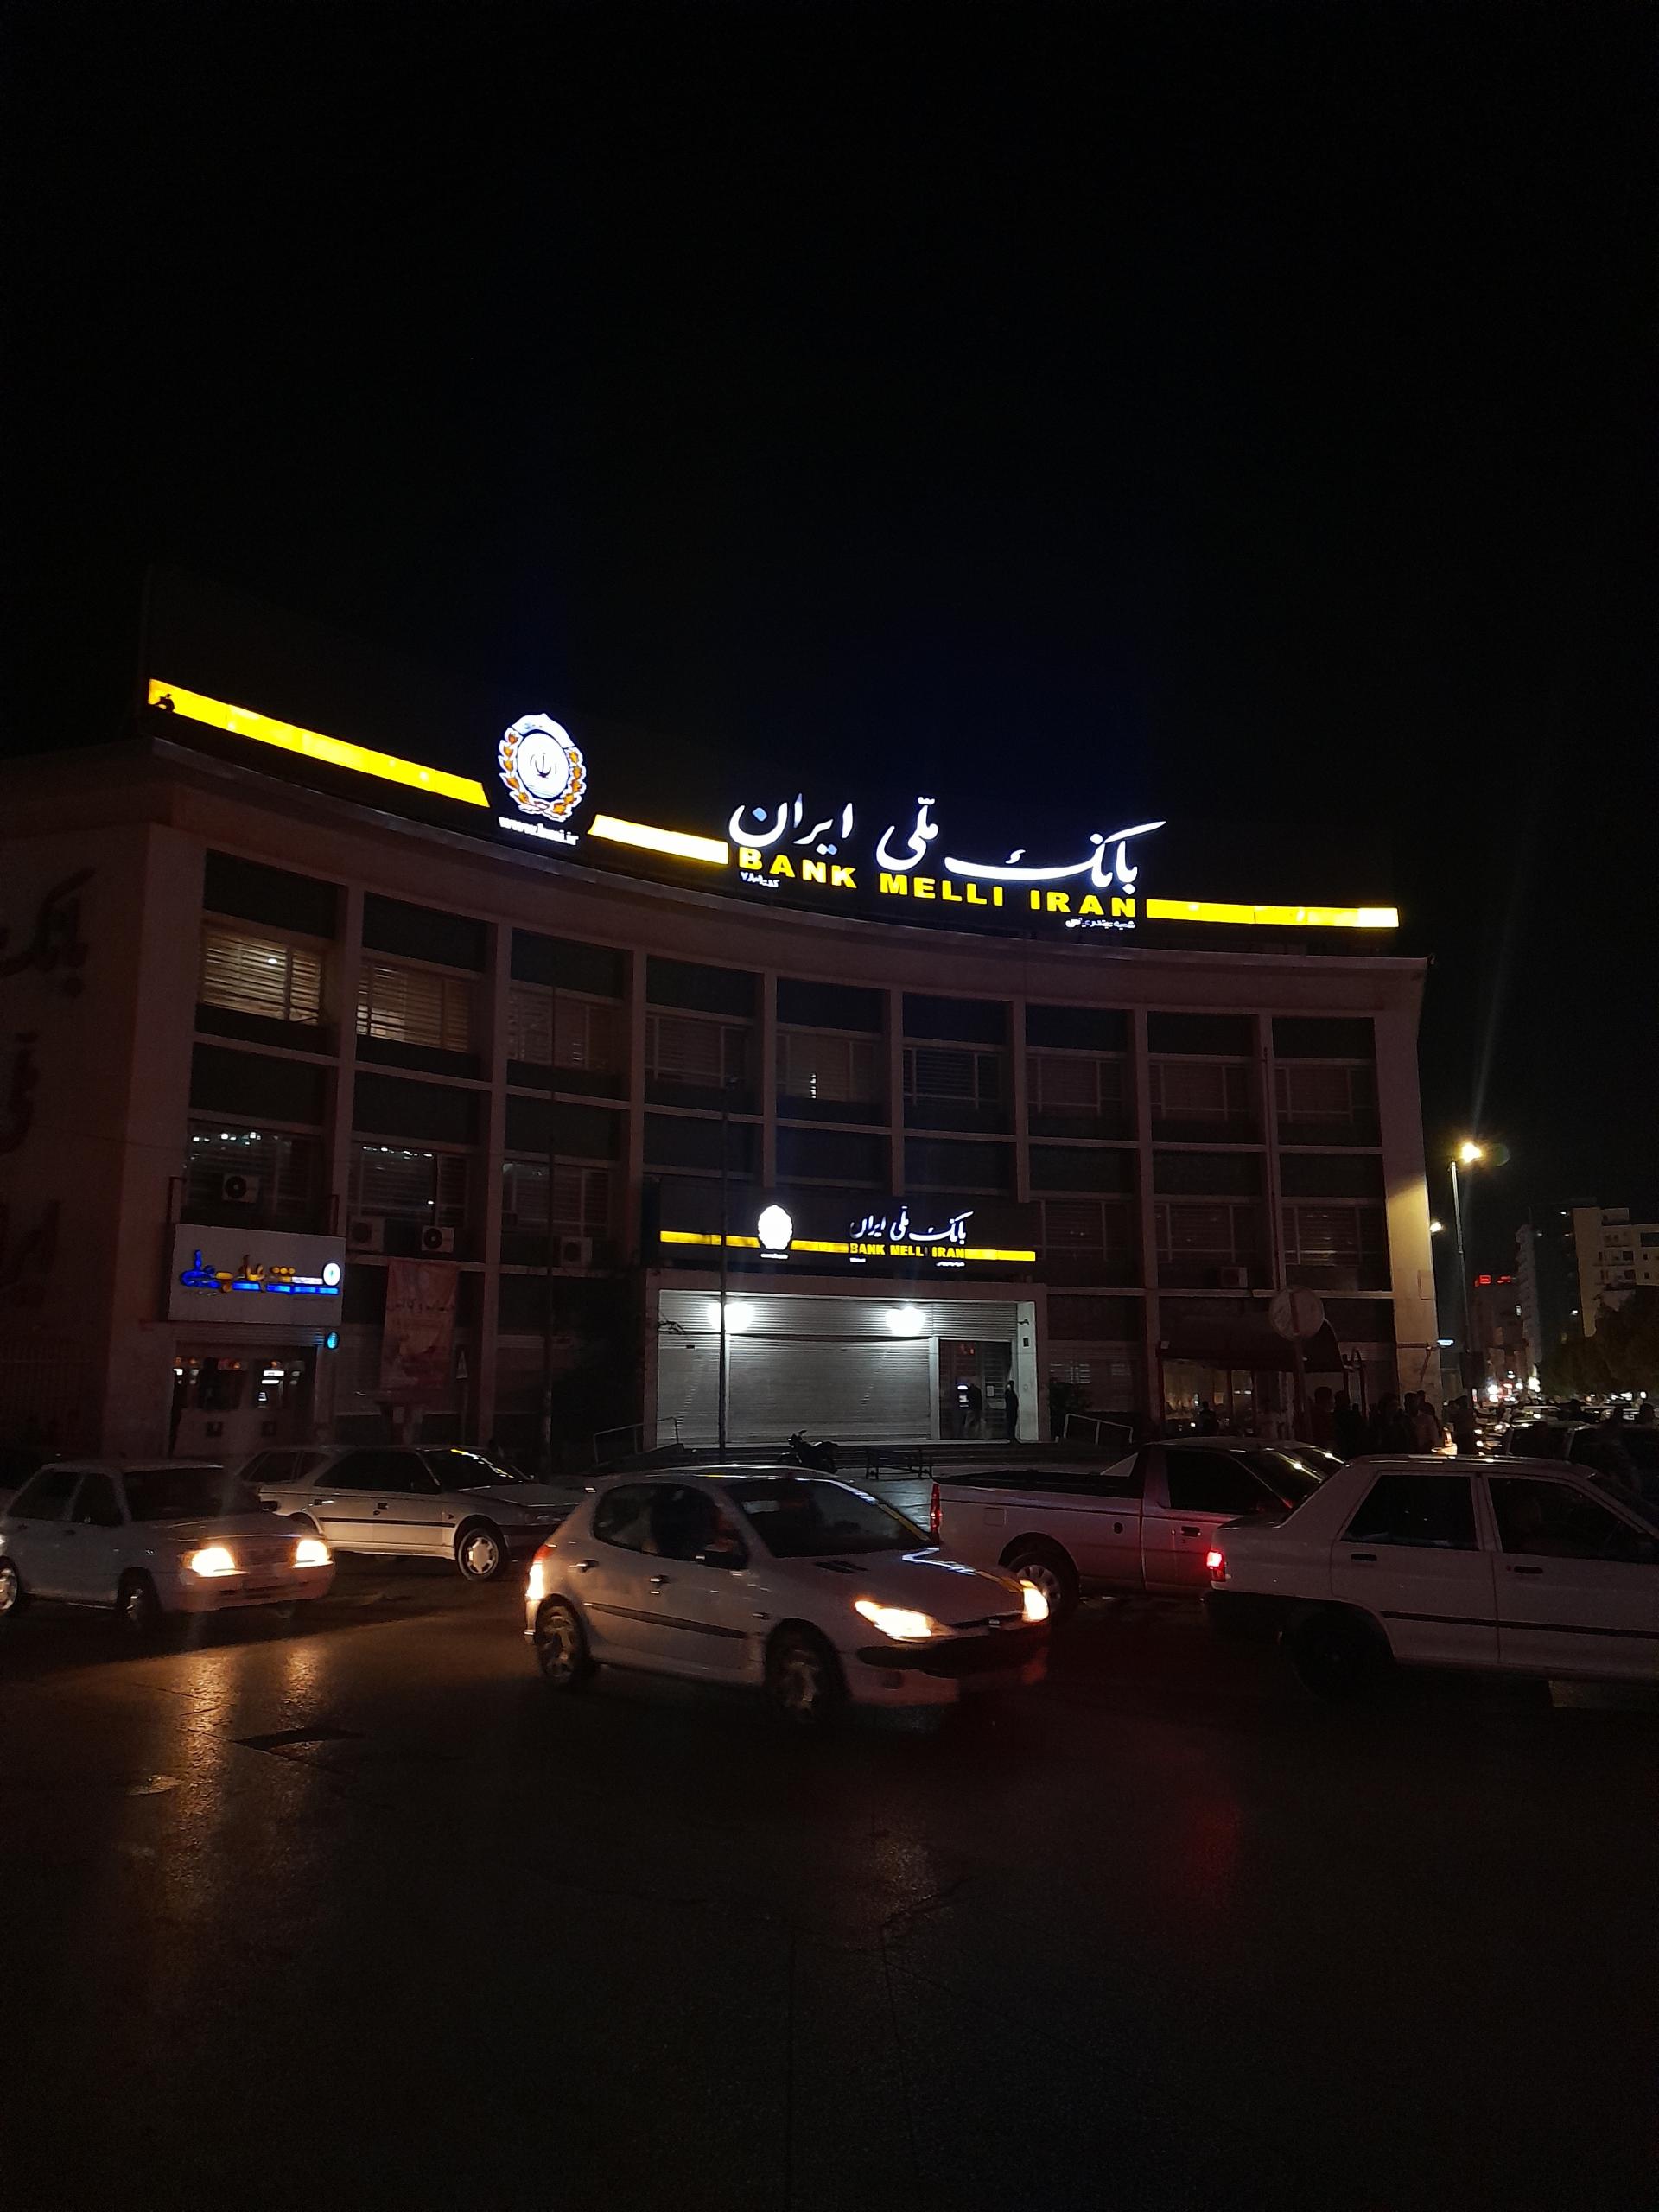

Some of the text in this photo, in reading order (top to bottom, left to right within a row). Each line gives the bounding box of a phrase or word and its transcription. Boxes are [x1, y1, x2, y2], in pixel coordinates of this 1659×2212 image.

[728, 793, 854, 855] ایران
[739, 847, 856, 889] BANK
[880, 872, 1003, 906] MELLI
[1030, 889, 1136, 918] IRAN
[849, 1243, 886, 1255] BANK
[931, 1246, 965, 1259] IRAN
